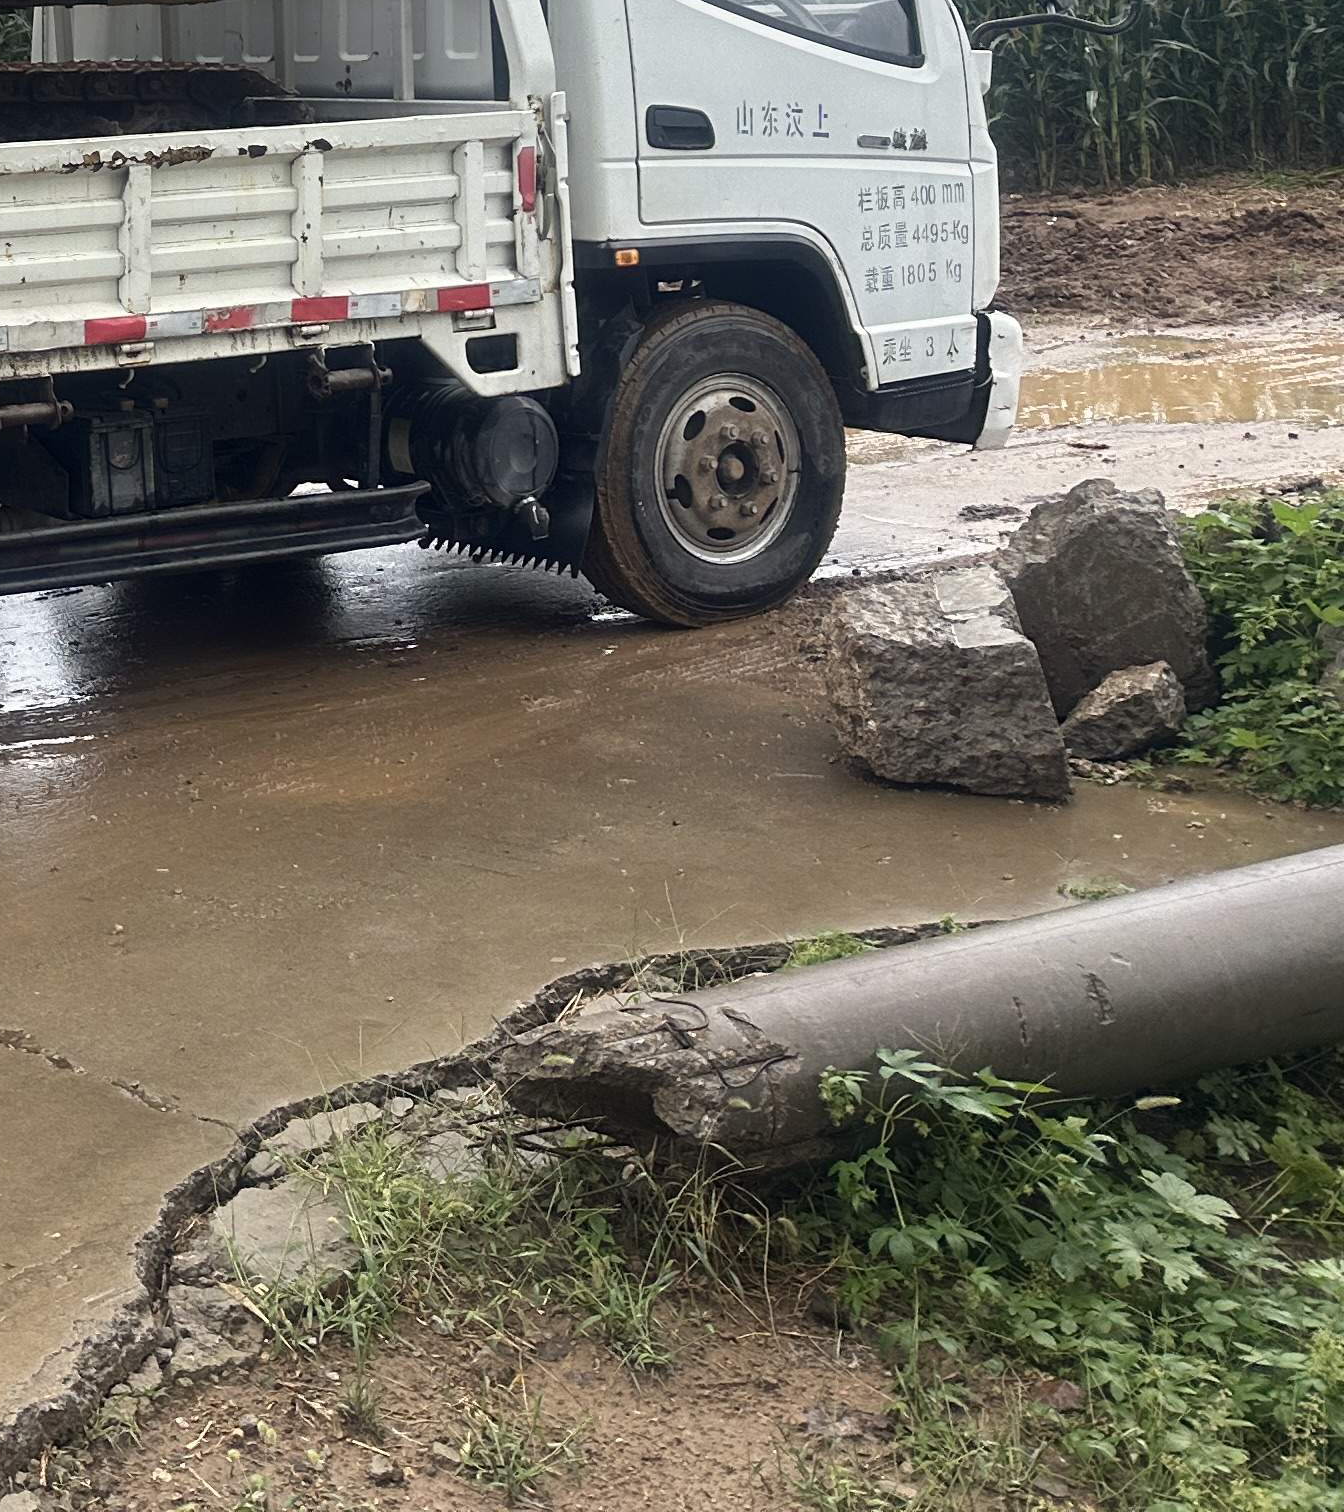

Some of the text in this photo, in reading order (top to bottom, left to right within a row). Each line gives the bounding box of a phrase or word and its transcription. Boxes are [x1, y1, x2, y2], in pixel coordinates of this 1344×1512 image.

[736, 100, 830, 138] 山东汶上
[911, 184, 937, 206] 400
[901, 261, 937, 287] 1805
[925, 336, 935, 357] 3
